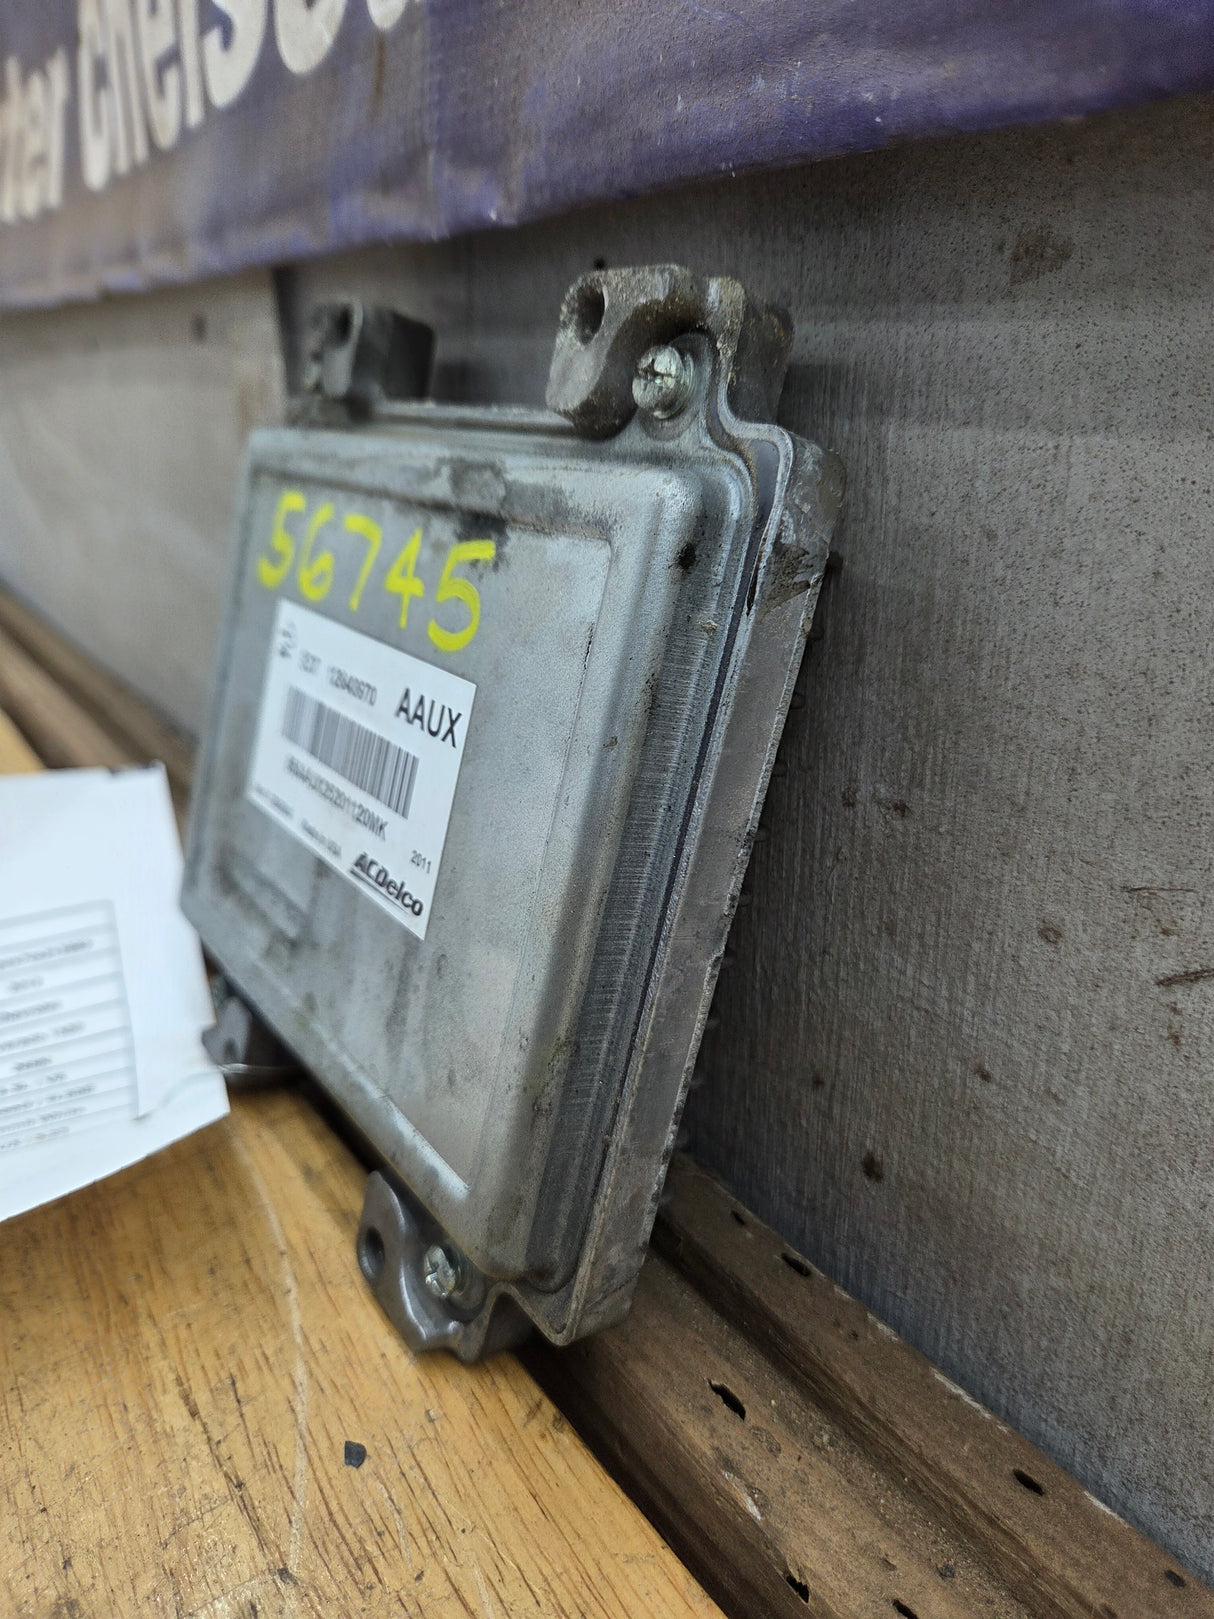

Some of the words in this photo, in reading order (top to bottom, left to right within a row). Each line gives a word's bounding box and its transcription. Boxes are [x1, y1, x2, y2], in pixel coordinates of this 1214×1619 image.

[257, 491, 497, 652] 56745
[395, 687, 463, 749] AAUX
[352, 850, 425, 917] ACDelco
[411, 849, 433, 875] 2011
